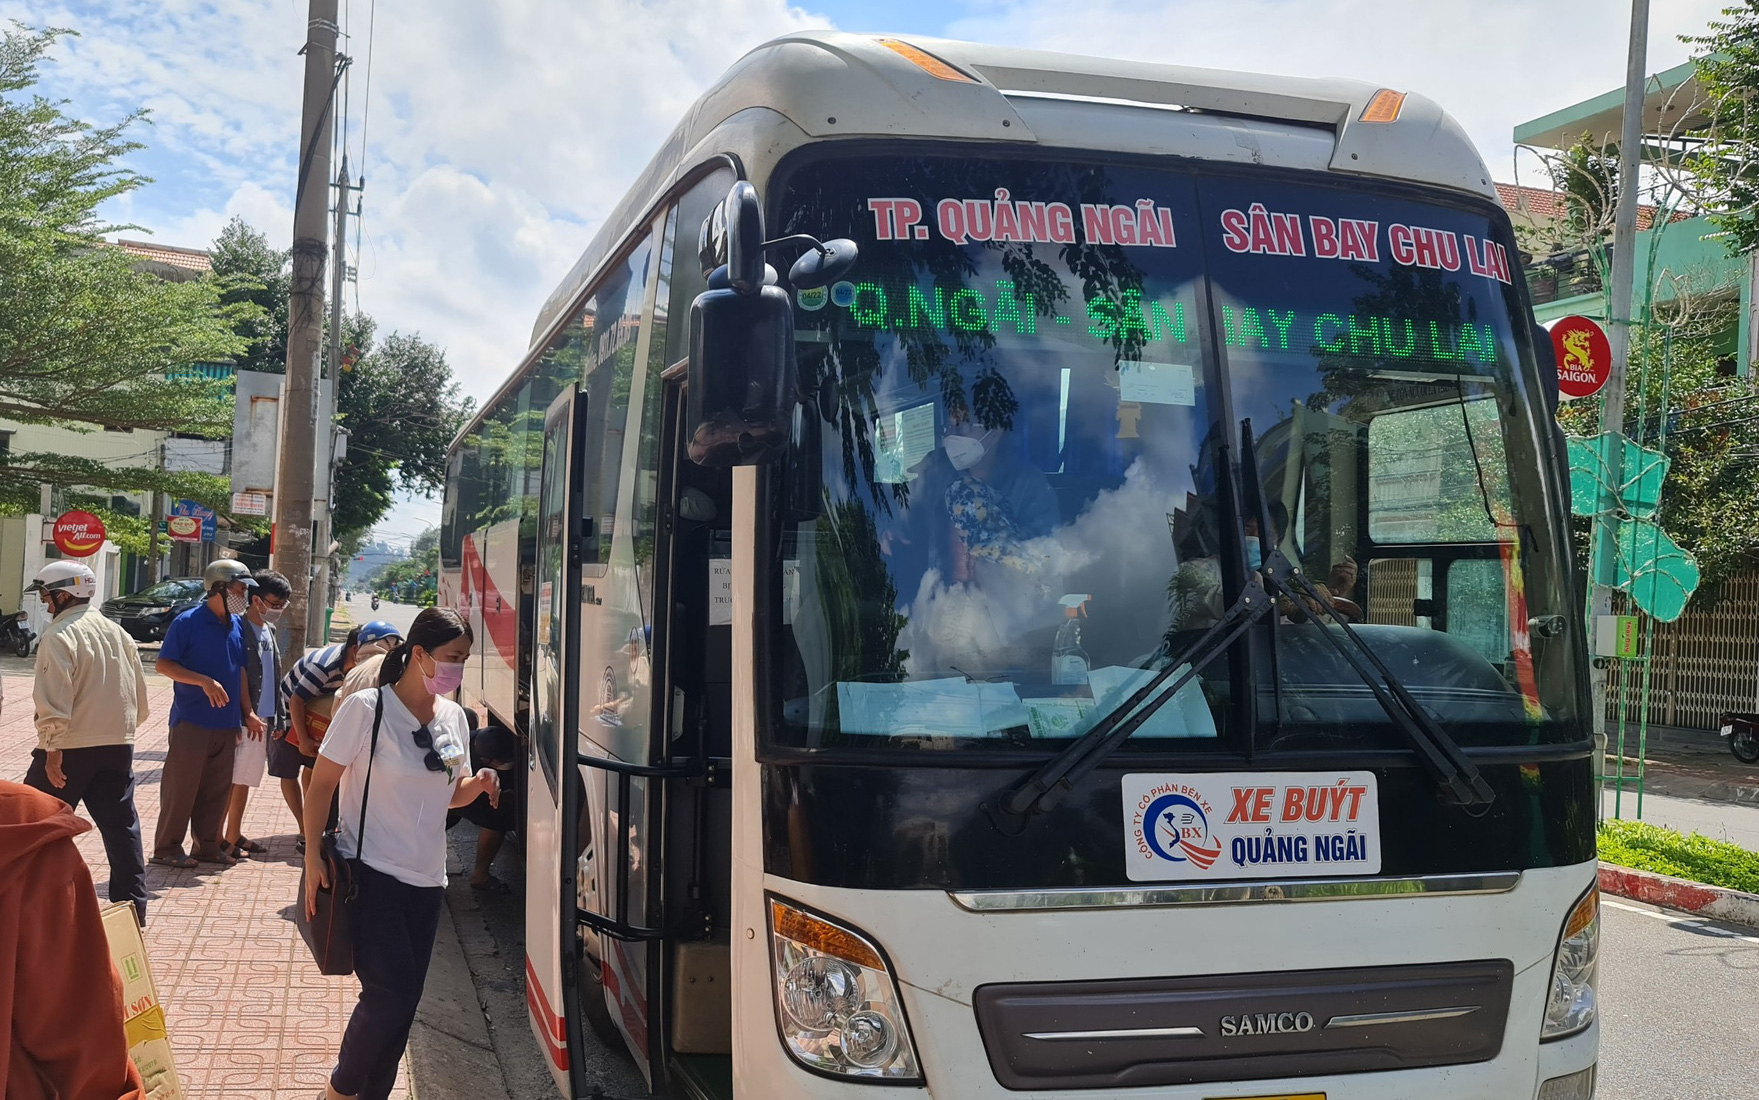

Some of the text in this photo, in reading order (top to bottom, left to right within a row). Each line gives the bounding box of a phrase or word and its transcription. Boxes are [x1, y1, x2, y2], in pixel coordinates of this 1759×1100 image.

[868, 188, 1177, 248] TP. QUẢNG NGÃI
[1220, 202, 1513, 285] SÂN BAY CHU LAI
[1085, 288, 1187, 343] SÂN
[1313, 313, 1415, 358] CHU
[1429, 320, 1496, 362] LAI
[1200, 800, 1213, 815] XE
[1224, 778, 1369, 824] XE BUÝT
[1181, 827, 1202, 838] BX
[1230, 827, 1367, 868] QUẢNG NGÃI
[1220, 1011, 1314, 1037] SAMCO
